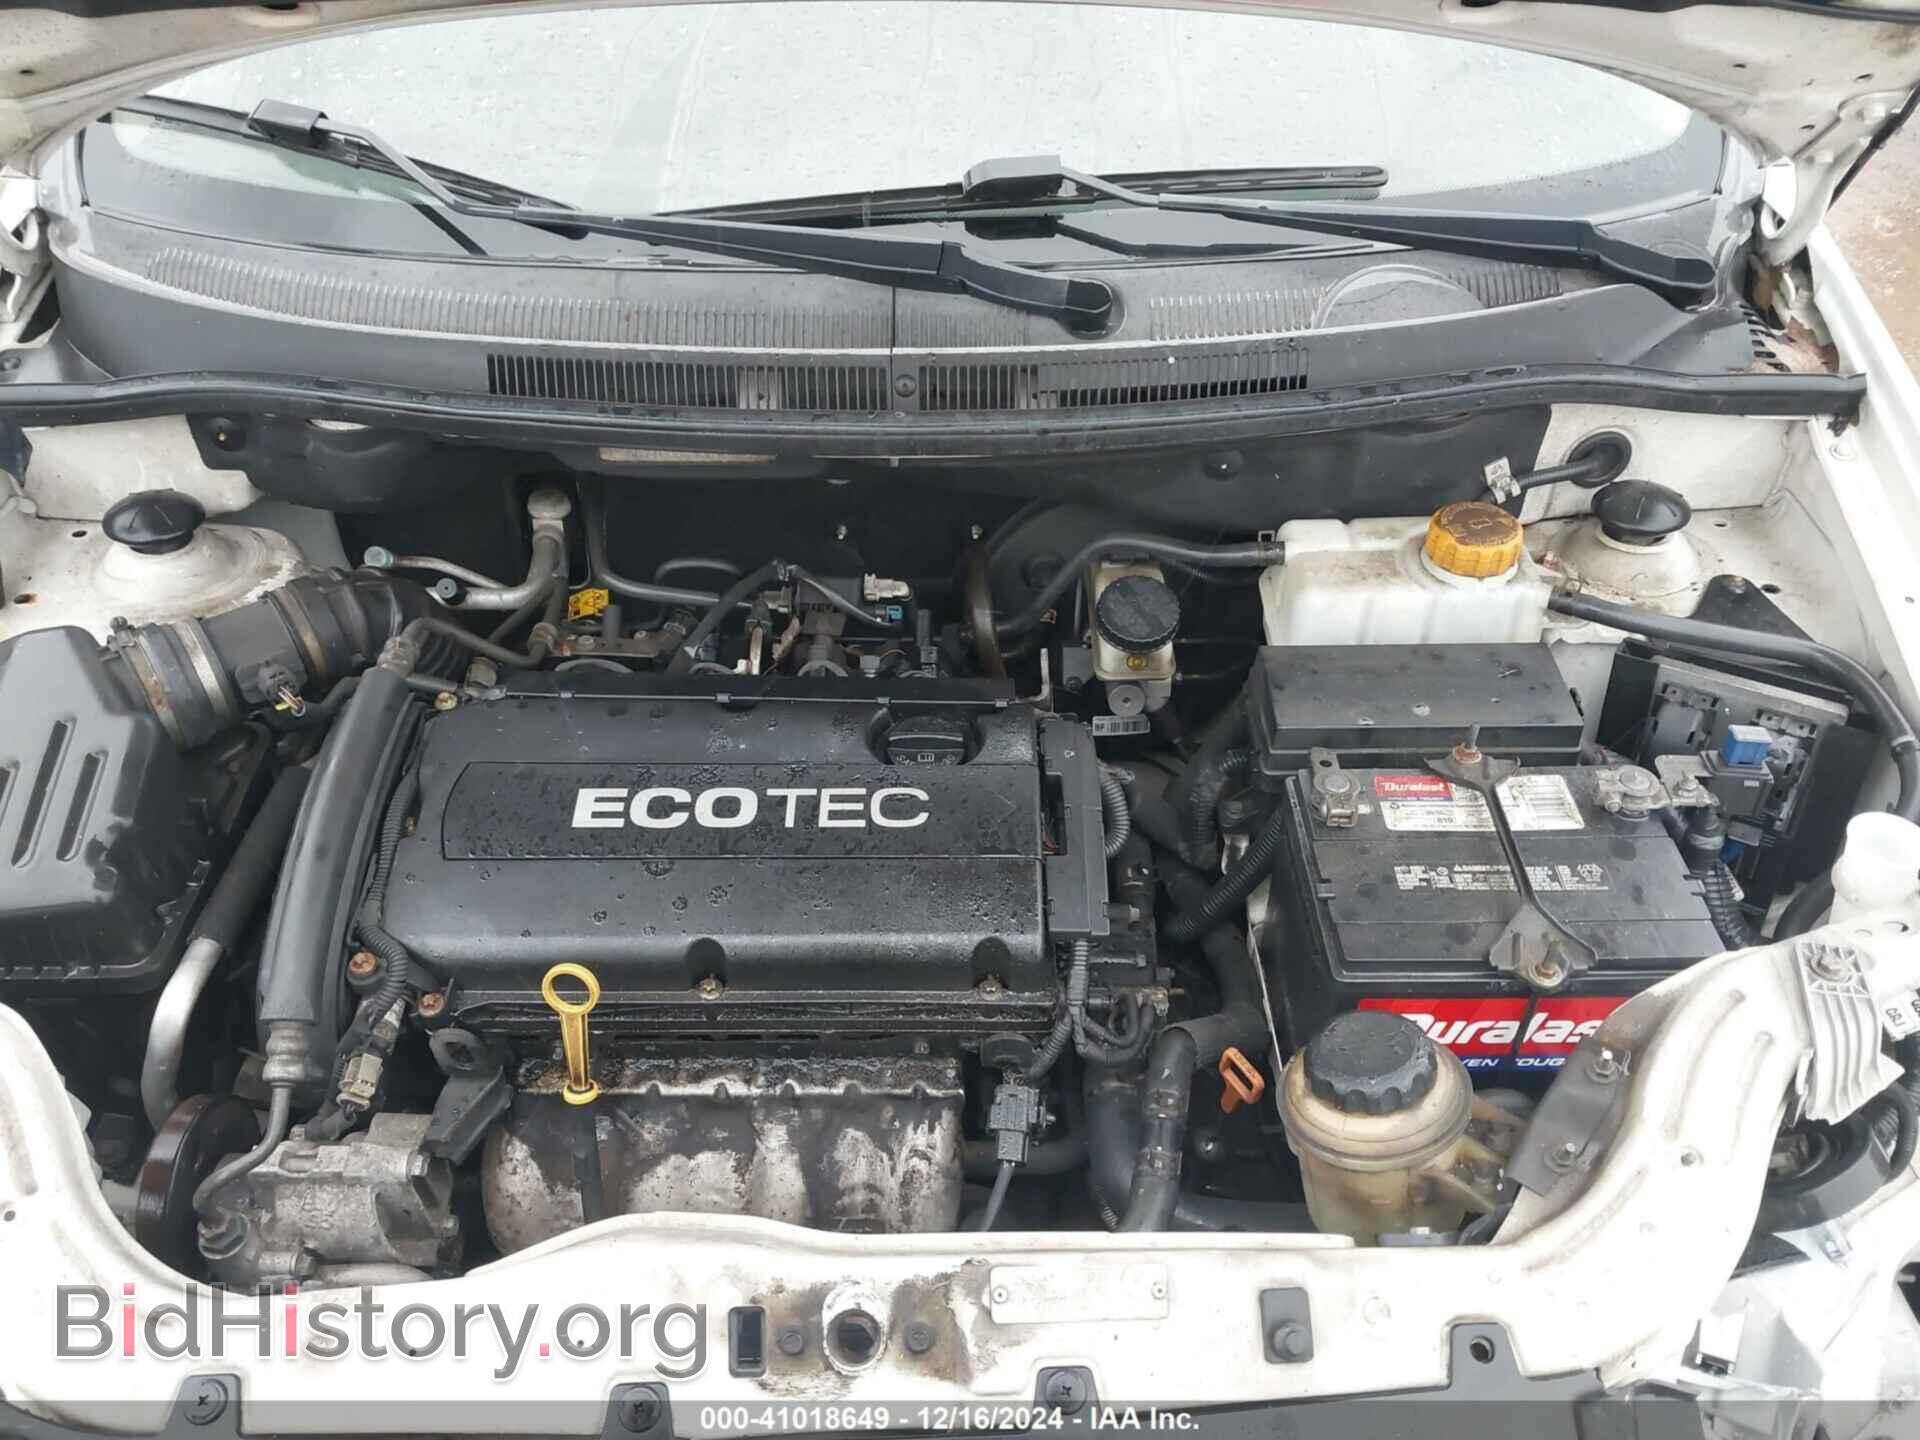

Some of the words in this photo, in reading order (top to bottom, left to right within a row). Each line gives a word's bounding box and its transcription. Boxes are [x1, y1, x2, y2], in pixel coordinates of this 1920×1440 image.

[572, 787, 931, 829] ECOTEC
[1401, 1012, 1603, 1044] Duralas
[1515, 1057, 1566, 1067] OUG
